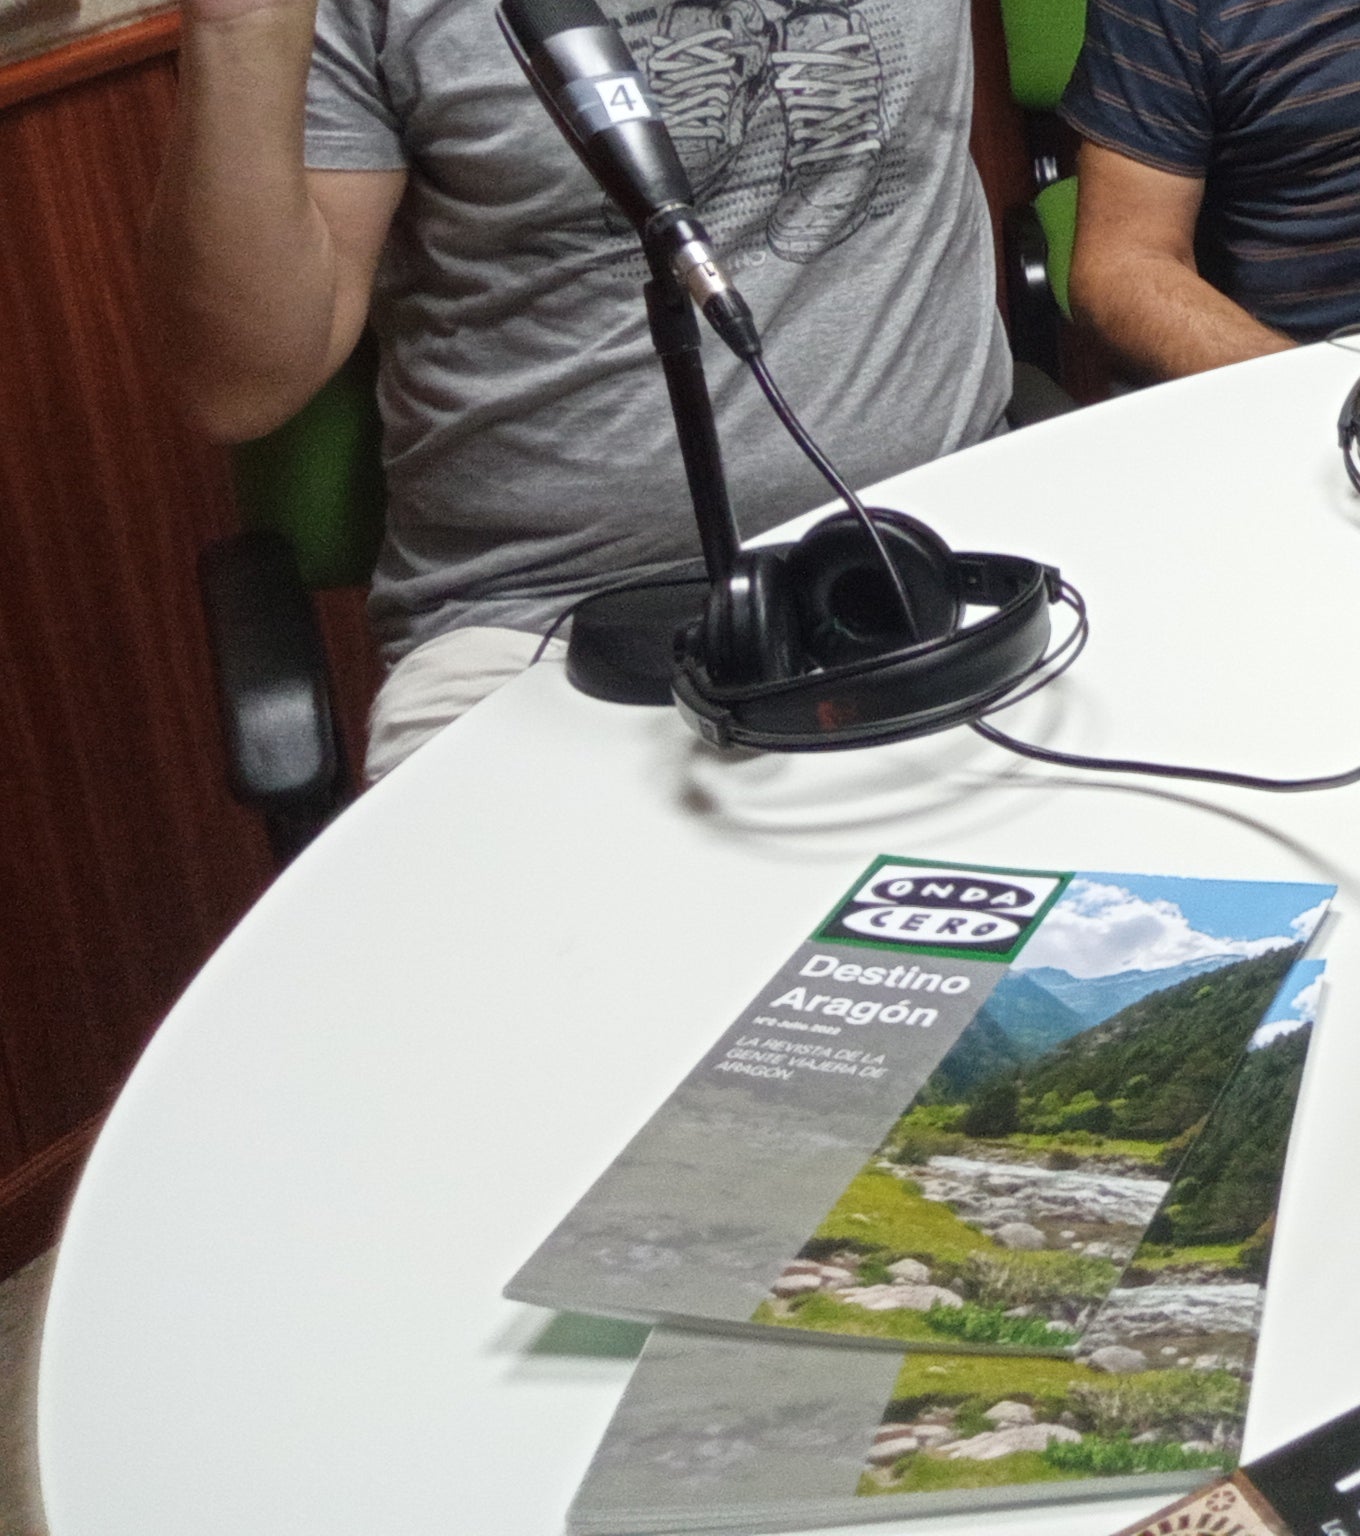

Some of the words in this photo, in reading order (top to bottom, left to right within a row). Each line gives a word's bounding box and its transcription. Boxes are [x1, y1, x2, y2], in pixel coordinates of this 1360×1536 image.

[609, 83, 638, 112] 4
[887, 880, 1018, 906] ONDA
[870, 910, 999, 937] CERO
[799, 954, 971, 995] Destino
[769, 986, 939, 1028] Aragón
[726, 1047, 788, 1064] GENTE
[735, 1035, 760, 1047] LA
[761, 1037, 832, 1058] REVISTA
